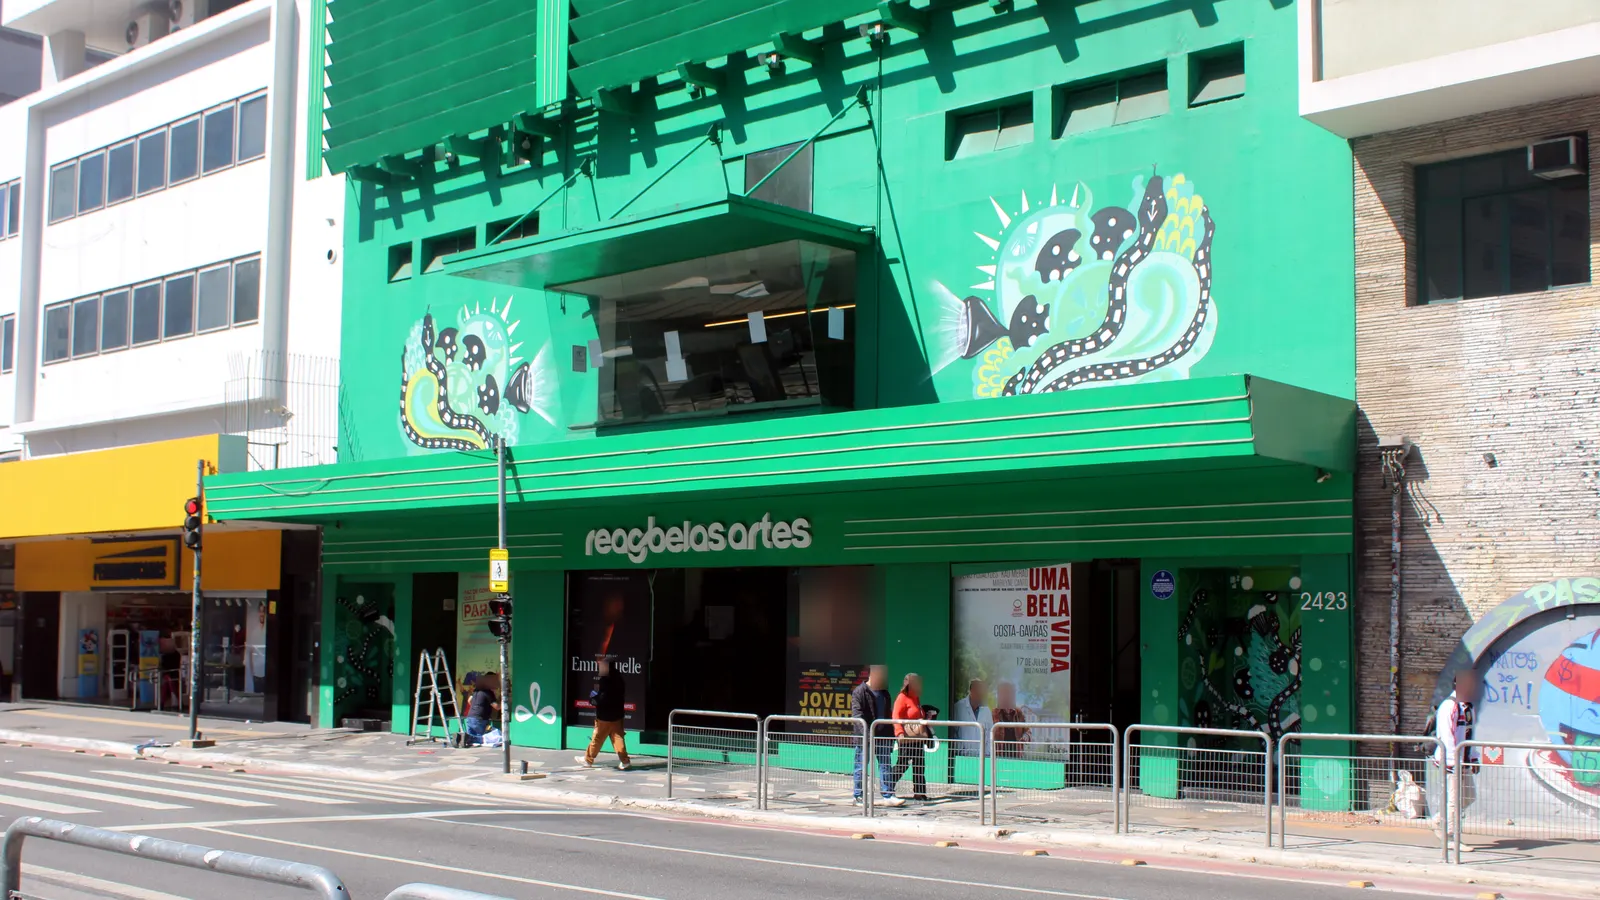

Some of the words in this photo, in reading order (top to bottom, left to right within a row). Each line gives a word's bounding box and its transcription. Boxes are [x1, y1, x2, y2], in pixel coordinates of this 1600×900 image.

[1029, 567, 1070, 591] UMA
[1027, 594, 1069, 617] BELA
[1301, 591, 1347, 611] 2423
[993, 625, 1048, 638] COSTA-GAVRAS
[1050, 620, 1070, 673] VIDA
[572, 657, 642, 675] Emmuelle
[799, 691, 853, 709] JOVEN
